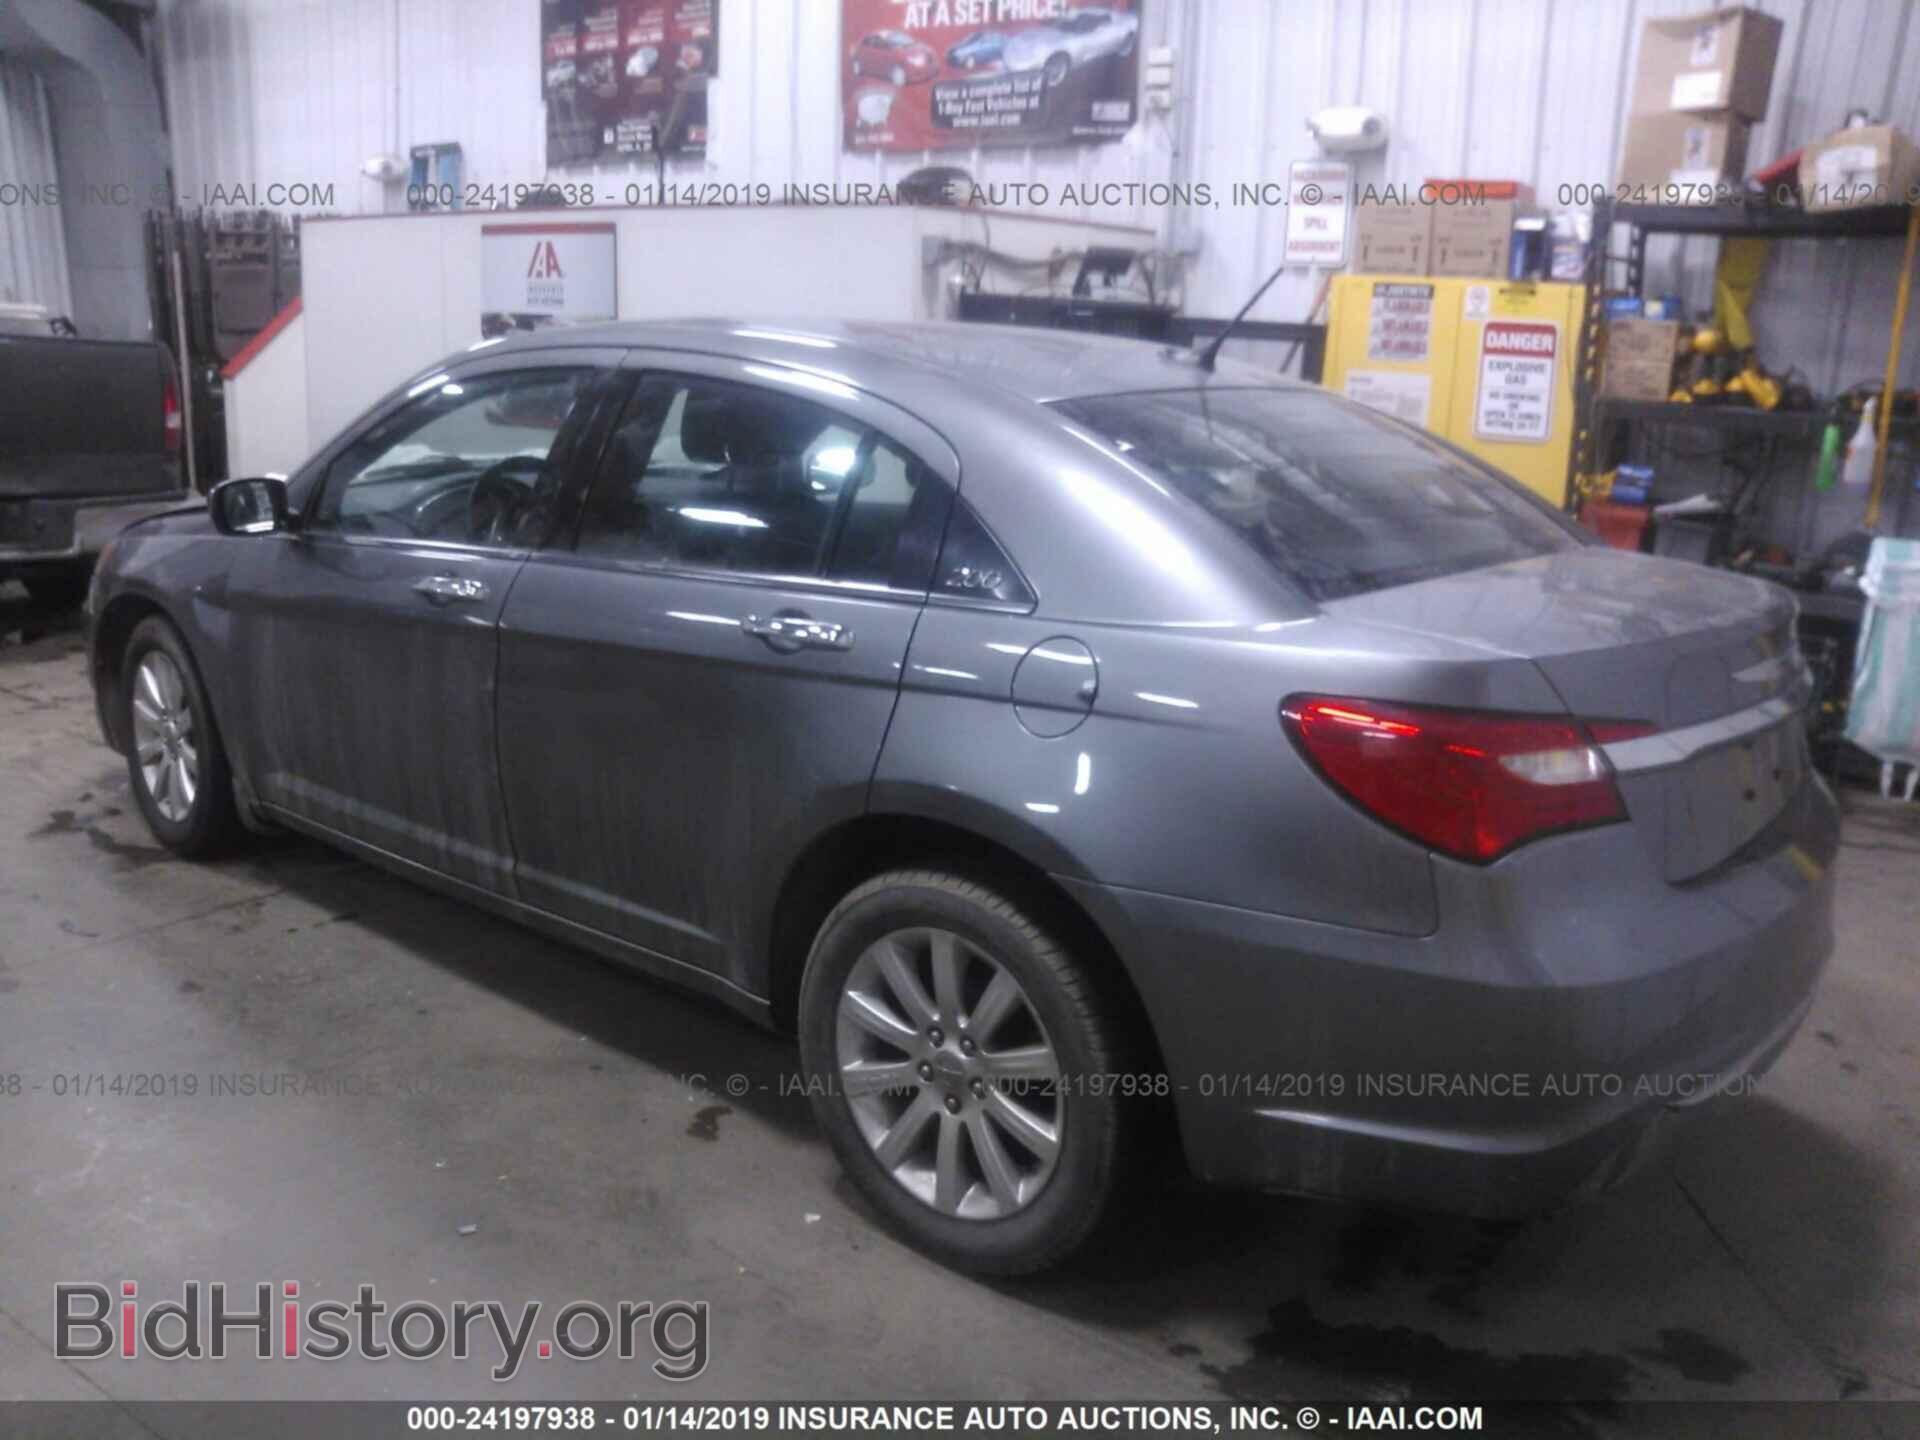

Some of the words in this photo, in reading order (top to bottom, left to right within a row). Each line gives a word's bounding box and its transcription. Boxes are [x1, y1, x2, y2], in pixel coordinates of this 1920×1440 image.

[903, 1, 931, 29] AT
[934, 0, 950, 27] A
[954, 0, 992, 25] SET
[1485, 329, 1555, 353] DANGER
